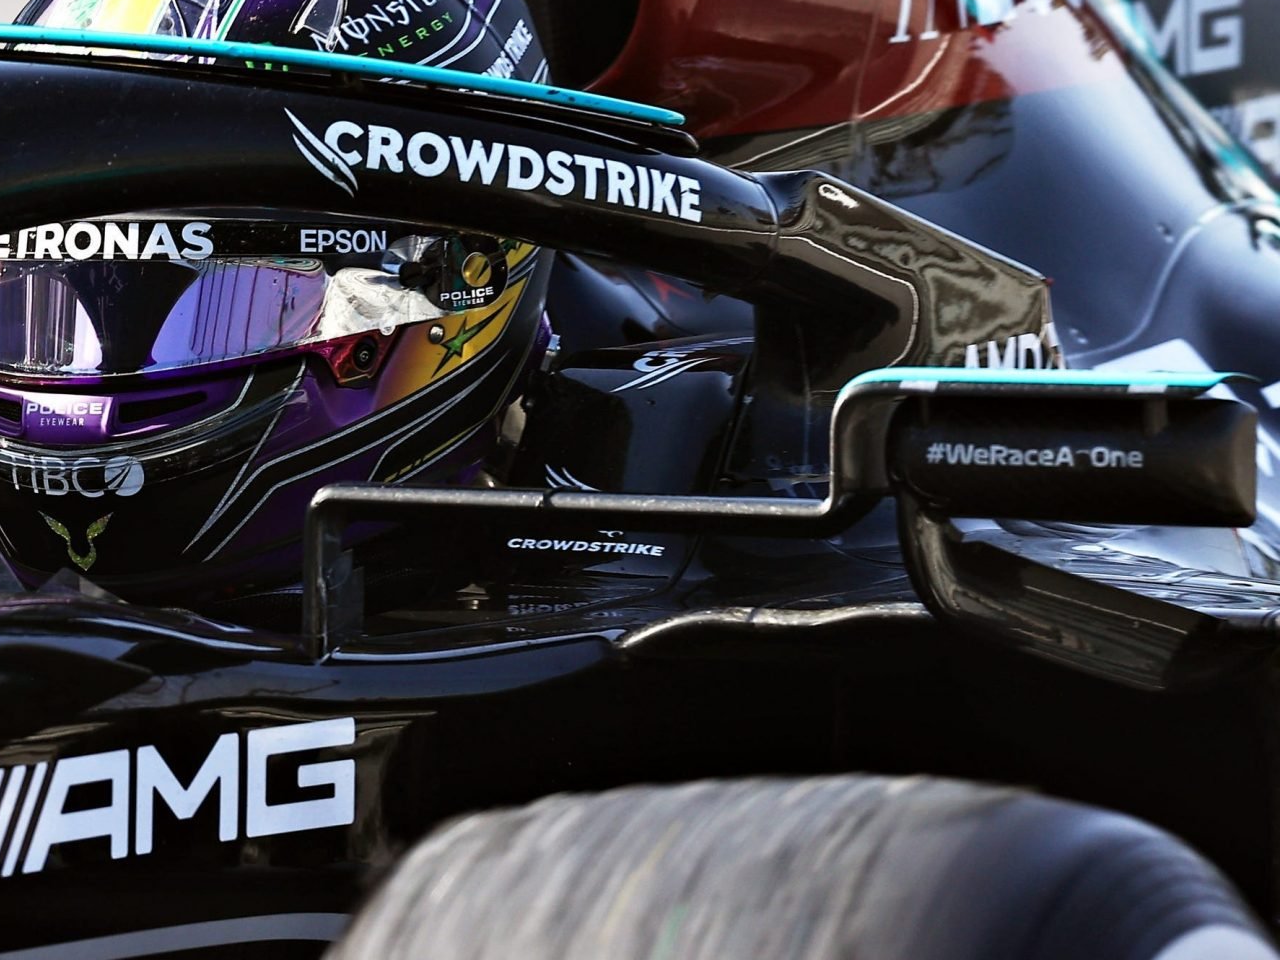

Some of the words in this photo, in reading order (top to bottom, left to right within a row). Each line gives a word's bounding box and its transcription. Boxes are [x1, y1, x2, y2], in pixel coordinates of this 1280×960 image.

[356, 10, 454, 58] NERGY
[324, 120, 703, 223] CROWDSTRIKE
[300, 228, 387, 253] EPSON
[439, 286, 495, 302] POLICE
[452, 297, 485, 307] EYEWEAR
[25, 401, 104, 415] POLICE
[39, 417, 85, 427] EYEWEAR
[926, 442, 1144, 468] #WeRaceAOne
[506, 538, 666, 557] CROWDSTRIKE
[22, 717, 356, 875] AMG
